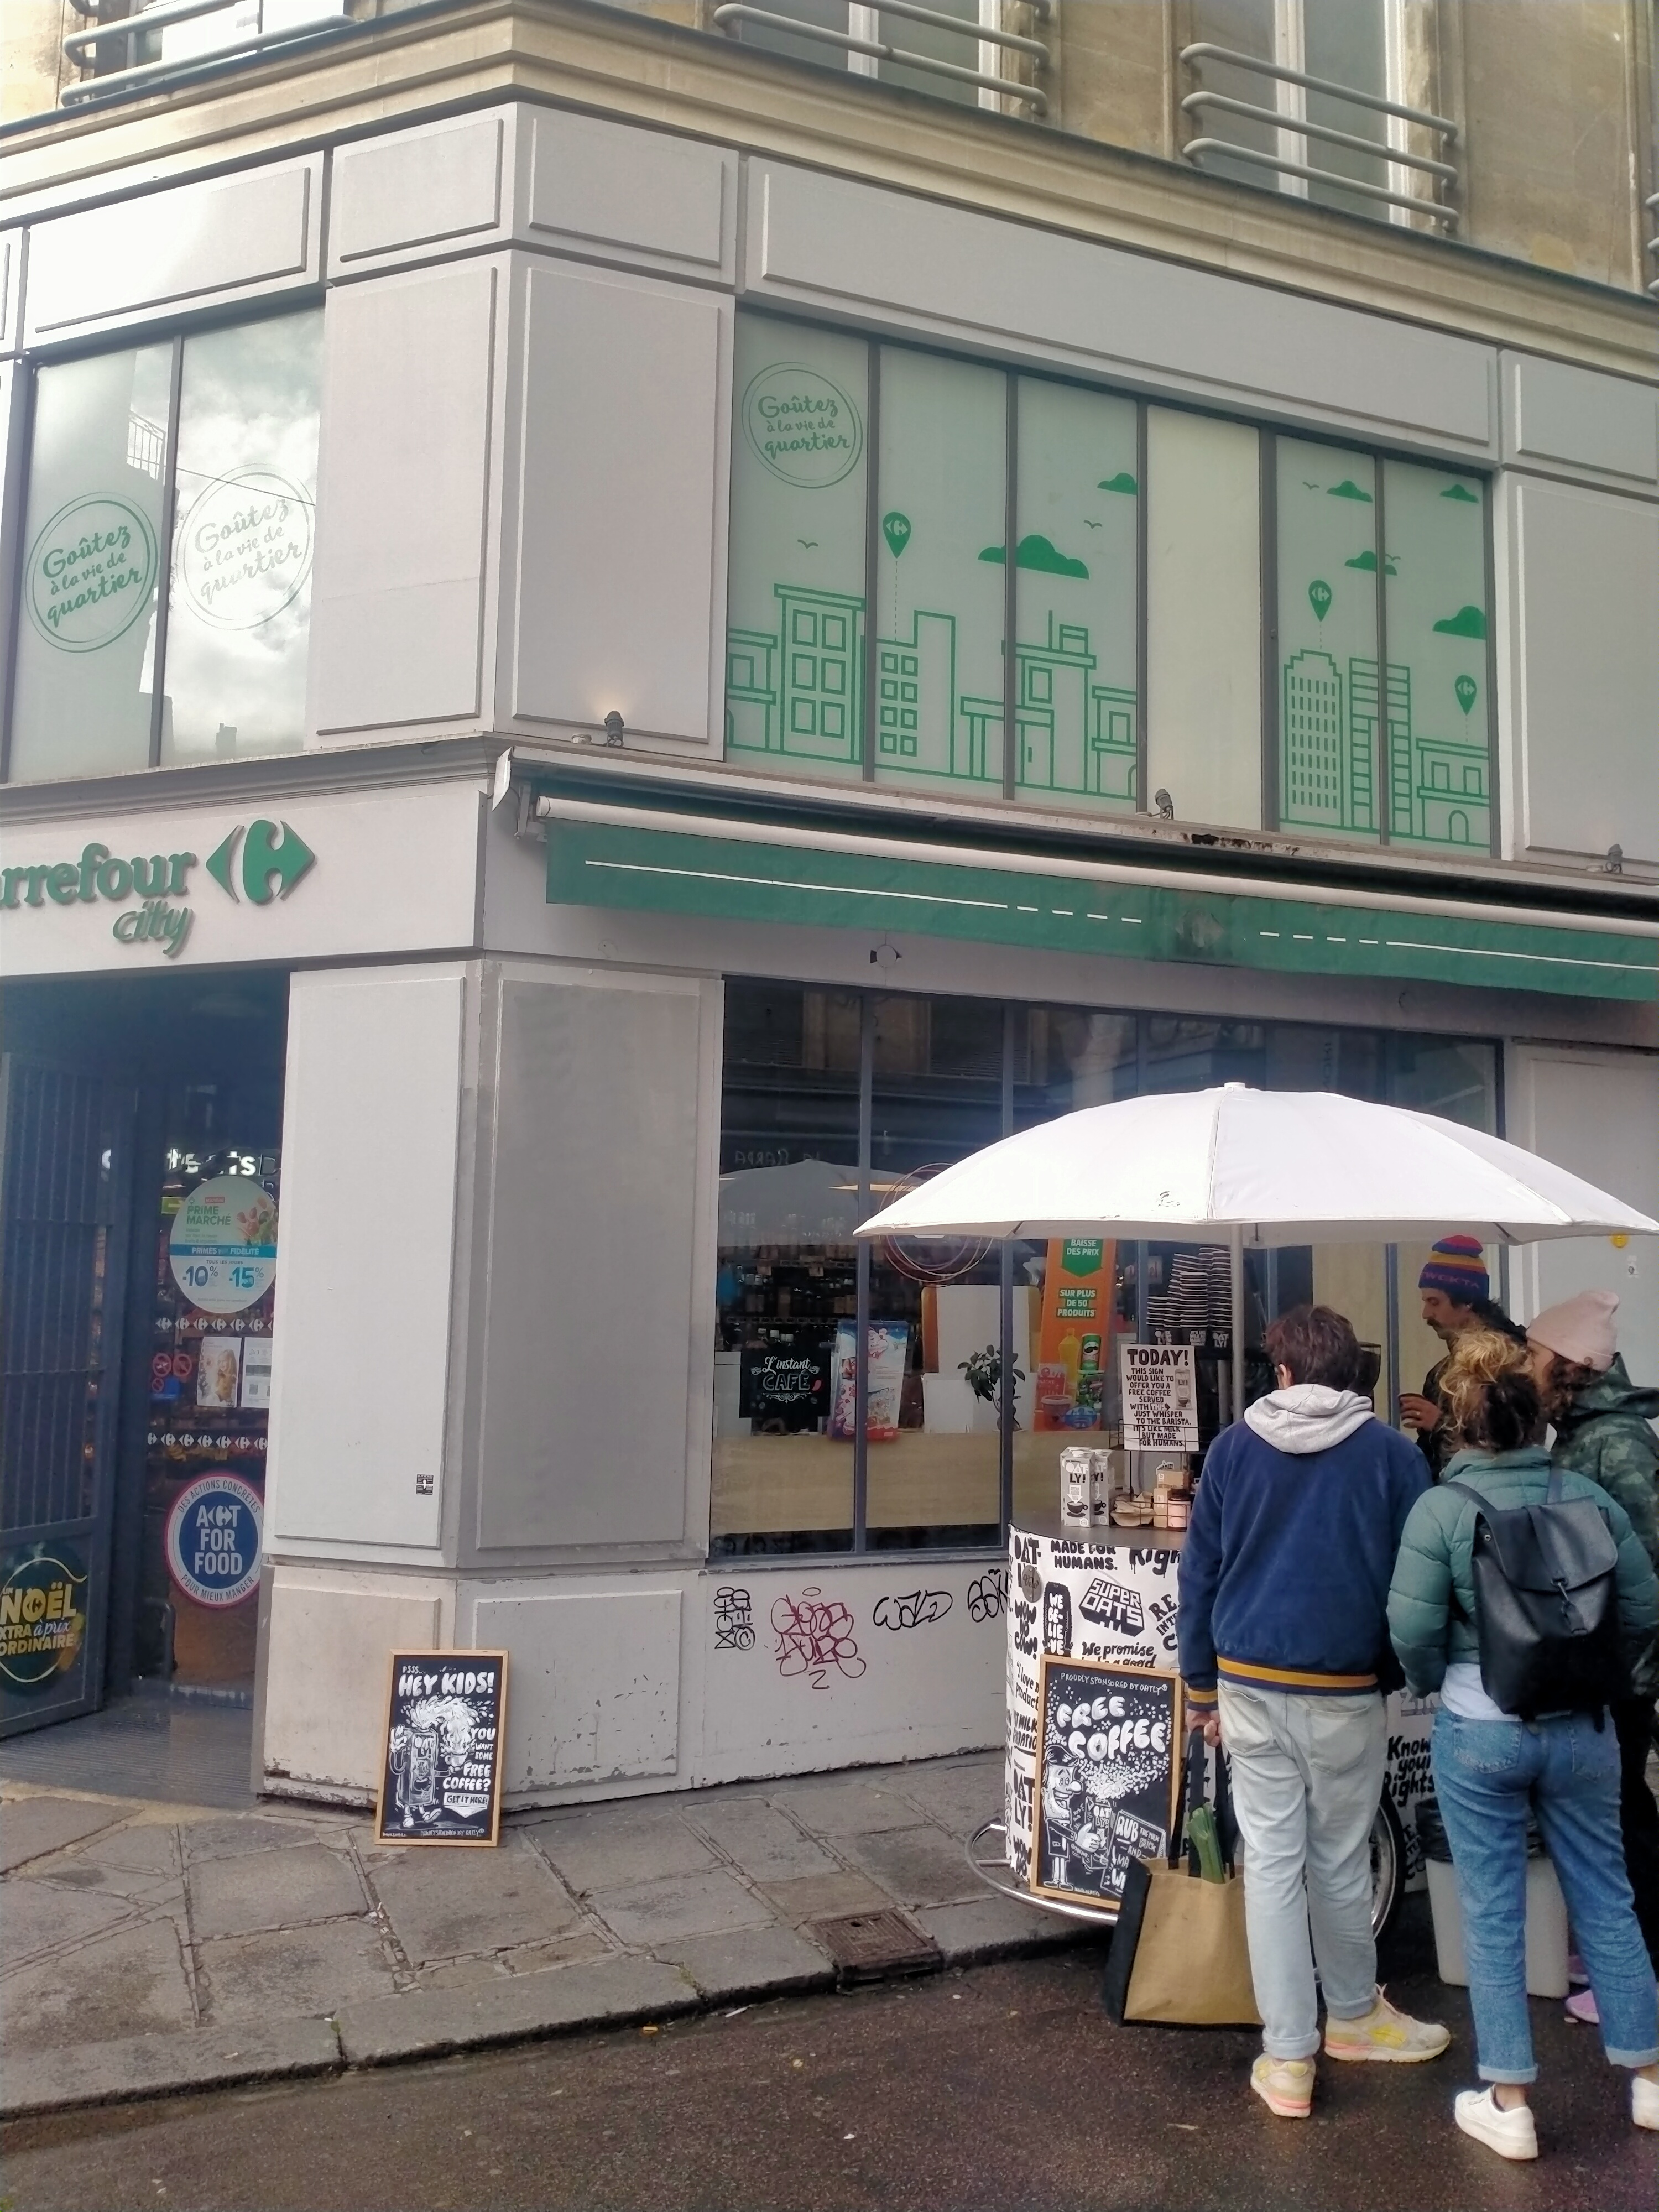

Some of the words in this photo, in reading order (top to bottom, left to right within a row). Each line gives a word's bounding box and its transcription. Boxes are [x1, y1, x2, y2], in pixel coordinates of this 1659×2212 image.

[758, 395, 838, 418] Goûtez
[766, 420, 776, 432] à
[776, 420, 792, 432] la
[794, 419, 816, 430] vie
[817, 417, 836, 429] de
[764, 432, 850, 460] quartier
[194, 498, 290, 554] Goûtez
[43, 525, 131, 578] Goûtez
[215, 547, 235, 564] la
[236, 539, 262, 555] vie
[263, 525, 285, 544] de
[50, 580, 60, 596] à
[61, 575, 80, 588] la
[81, 563, 104, 581] vie
[106, 552, 127, 570] de
[200, 542, 302, 606] quartier
[46, 568, 143, 628] quartier
[0, 842, 197, 909] rrefour
[112, 900, 194, 958] city
[186, 1213, 231, 1225] MARCHÉ
[187, 1205, 219, 1215] PRIME
[1071, 1239, 1097, 1247] BAISSE
[1076, 1289, 1096, 1297] PLUS
[1077, 1299, 1088, 1307] 50
[762, 1355, 811, 1375] L'instant
[1126, 1349, 1189, 1366] TODAY!
[763, 1369, 811, 1391] CAFÉ
[1070, 1473, 1086, 1483] LY!
[178, 1497, 191, 1513] DES
[191, 1479, 221, 1498] ACTIONS
[222, 1480, 260, 1514] CONCRÈTES
[200, 1528, 236, 1551] FOR
[1051, 1540, 1085, 1554] MADE
[1088, 1541, 1117, 1555] FOR
[195, 1552, 242, 1575] FOOD
[1054, 1555, 1118, 1571] HUMANS.
[181, 1574, 200, 1594] POUR
[200, 1589, 223, 1601] MIEUX
[226, 1576, 254, 1600] MANGER
[0, 1581, 77, 1625] NOËL
[1048, 1592, 1063, 1609] WE
[1081, 1592, 1144, 1628] OATS
[1148, 1593, 1178, 1622] RE
[33, 1619, 44, 1637] à
[42, 1616, 71, 1642] prix
[1047, 1622, 1063, 1640] LIE
[0, 1633, 75, 1657] ORDINAIRE
[1082, 1641, 1101, 1656] We
[1103, 1641, 1155, 1660] promise
[398, 1673, 439, 1697] HEY
[441, 1672, 495, 1695] KIDS!
[1021, 1666, 1034, 1690] love
[1061, 1672, 1090, 1684] PROUDLY
[1090, 1677, 1128, 1689] SPONSORED
[1056, 1695, 1125, 1728] FREE
[470, 1727, 496, 1741] YOU
[1018, 1714, 1038, 1734] MILK
[1068, 1718, 1166, 1761] COFFEE
[1387, 1735, 1431, 1762] Know
[474, 1752, 493, 1760] SOME
[463, 1763, 491, 1777] FREE
[443, 1776, 491, 1791] COFFEE?
[1383, 1772, 1436, 1808] Rights
[470, 1796, 488, 1805] HERE!
[1093, 1806, 1112, 1818] OAT
[1015, 1797, 1033, 1832] LY!
[1115, 1815, 1139, 1843] RUB
[1139, 1826, 1149, 1838] THE
[1148, 1833, 1160, 1843] MILK
[1126, 1845, 1142, 1858] AND
[1138, 1837, 1157, 1853] BRICK
[1111, 1867, 1126, 1890] WI
